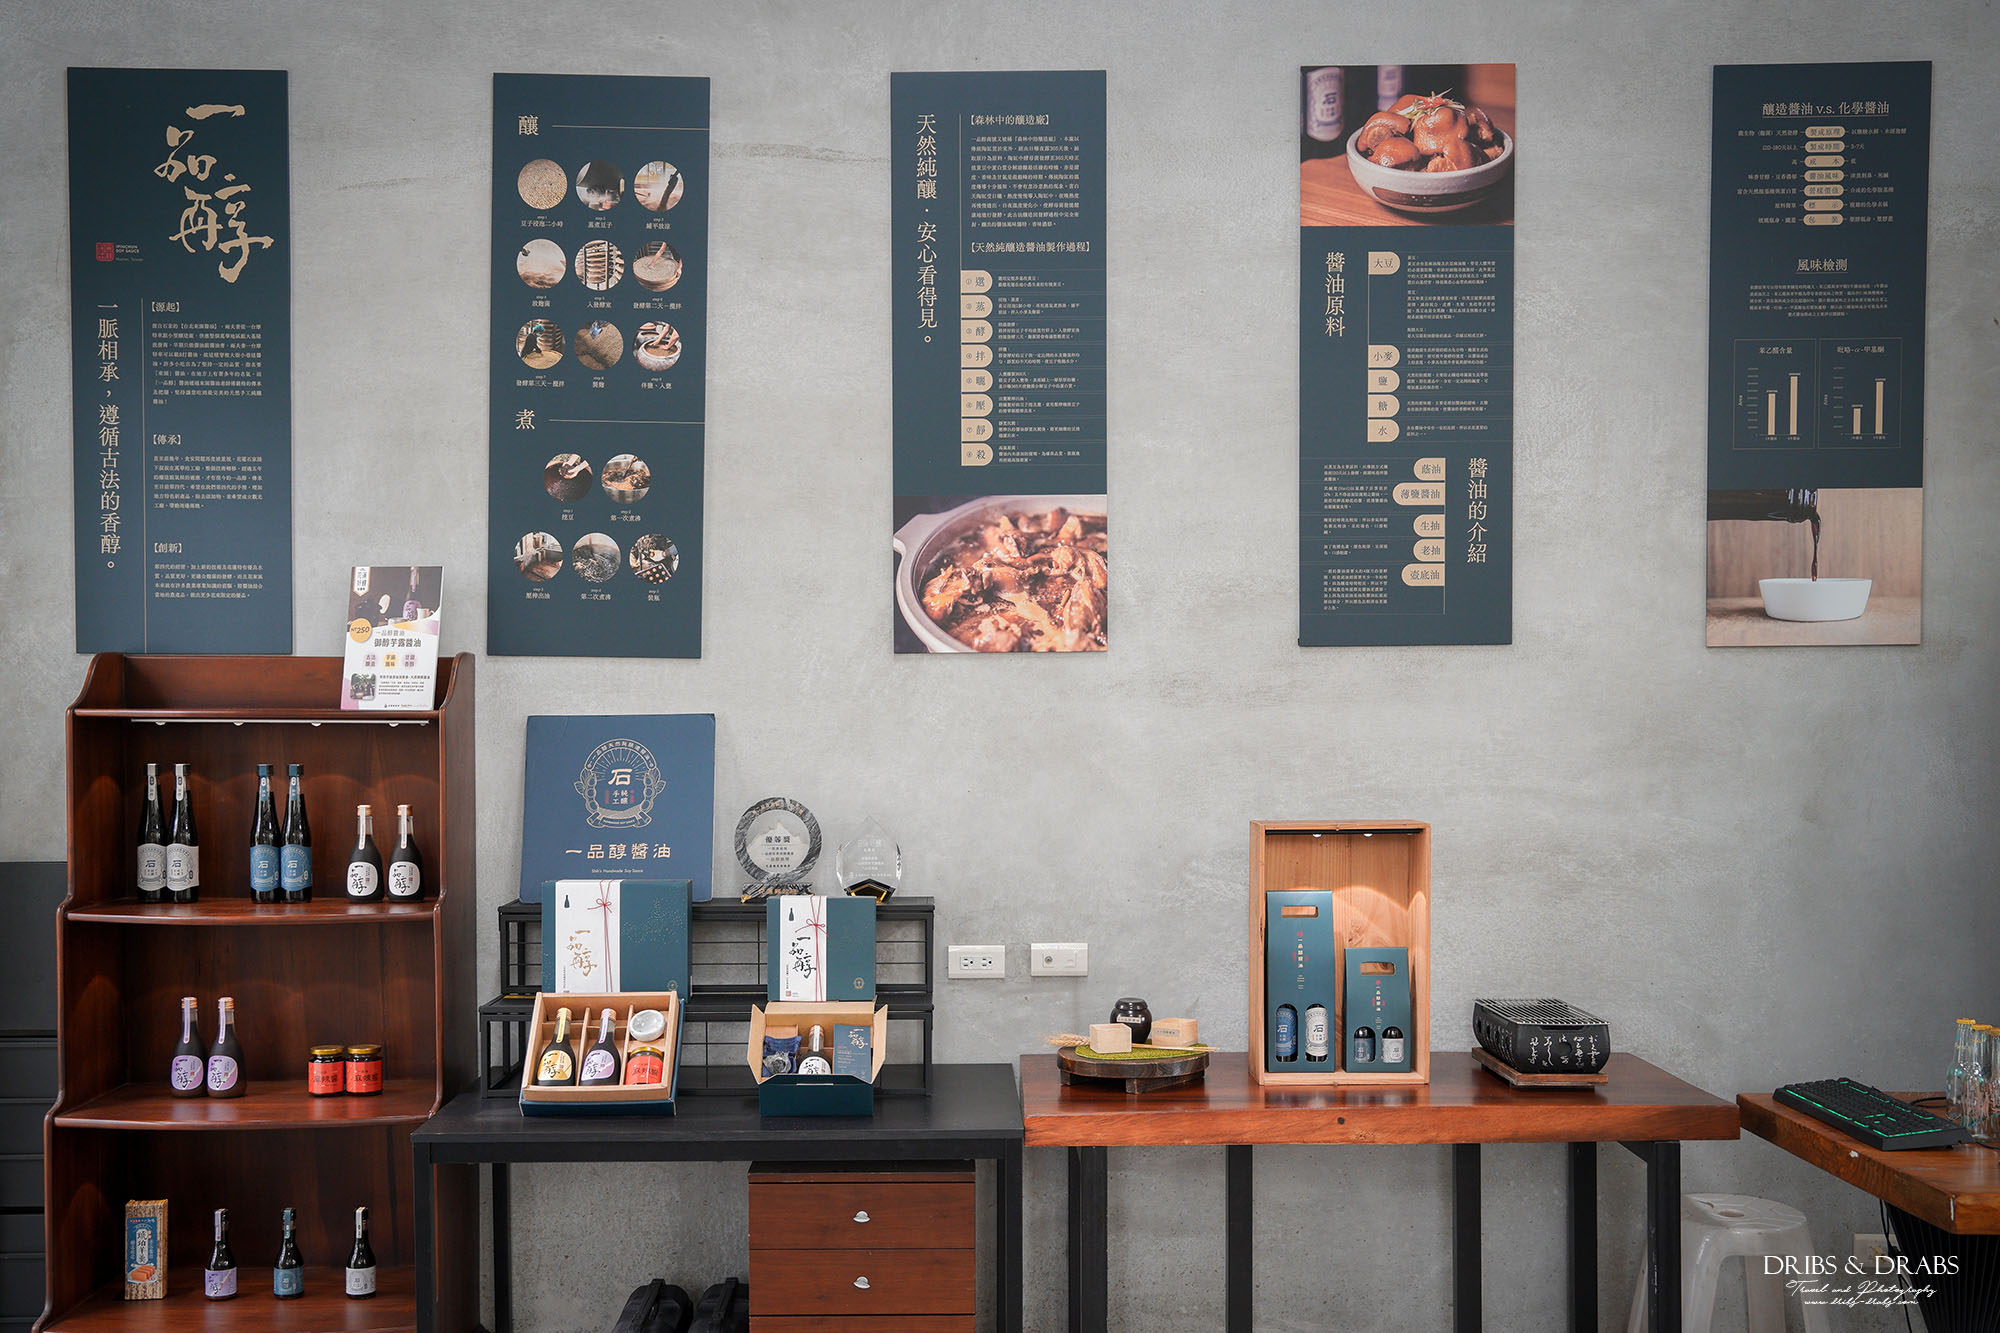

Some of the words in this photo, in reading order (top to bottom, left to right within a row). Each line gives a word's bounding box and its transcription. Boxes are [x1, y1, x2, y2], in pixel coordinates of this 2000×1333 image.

[1762, 103, 1813, 116] 釀造醬油
[1816, 105, 1834, 114] v.s.
[1838, 101, 1890, 114] 化學醬油
[518, 115, 539, 136] 釀
[970, 114, 1050, 126] 【森林中的釀造廠】
[970, 241, 1091, 253] 【天然純釀造醬油製作過程】
[1373, 258, 1394, 268] 大豆
[1796, 258, 1848, 272] 風味檢測
[975, 277, 986, 287] 選
[1325, 252, 1346, 337] 醬油原料
[975, 301, 986, 312] 蒸
[975, 326, 986, 337] 酵
[975, 351, 986, 361] 拌
[1378, 376, 1388, 386] 鹽
[975, 400, 986, 410] 壓
[1378, 400, 1388, 411] 糖
[515, 408, 536, 430] 煮
[975, 425, 986, 435] 靜
[1378, 426, 1388, 436] 水
[975, 450, 986, 460] 殺
[1400, 489, 1440, 499] 薄鹽醬油
[1467, 458, 1488, 564] 醬油的介紹
[1420, 521, 1440, 531] 生抽
[154, 542, 182, 553] 【創新】
[1421, 545, 1440, 556] 老抽
[608, 768, 632, 786] 石
[565, 842, 671, 860] 一品醇醬油
[1277, 1024, 1288, 1033] 石
[1314, 1024, 1324, 1033] 石
